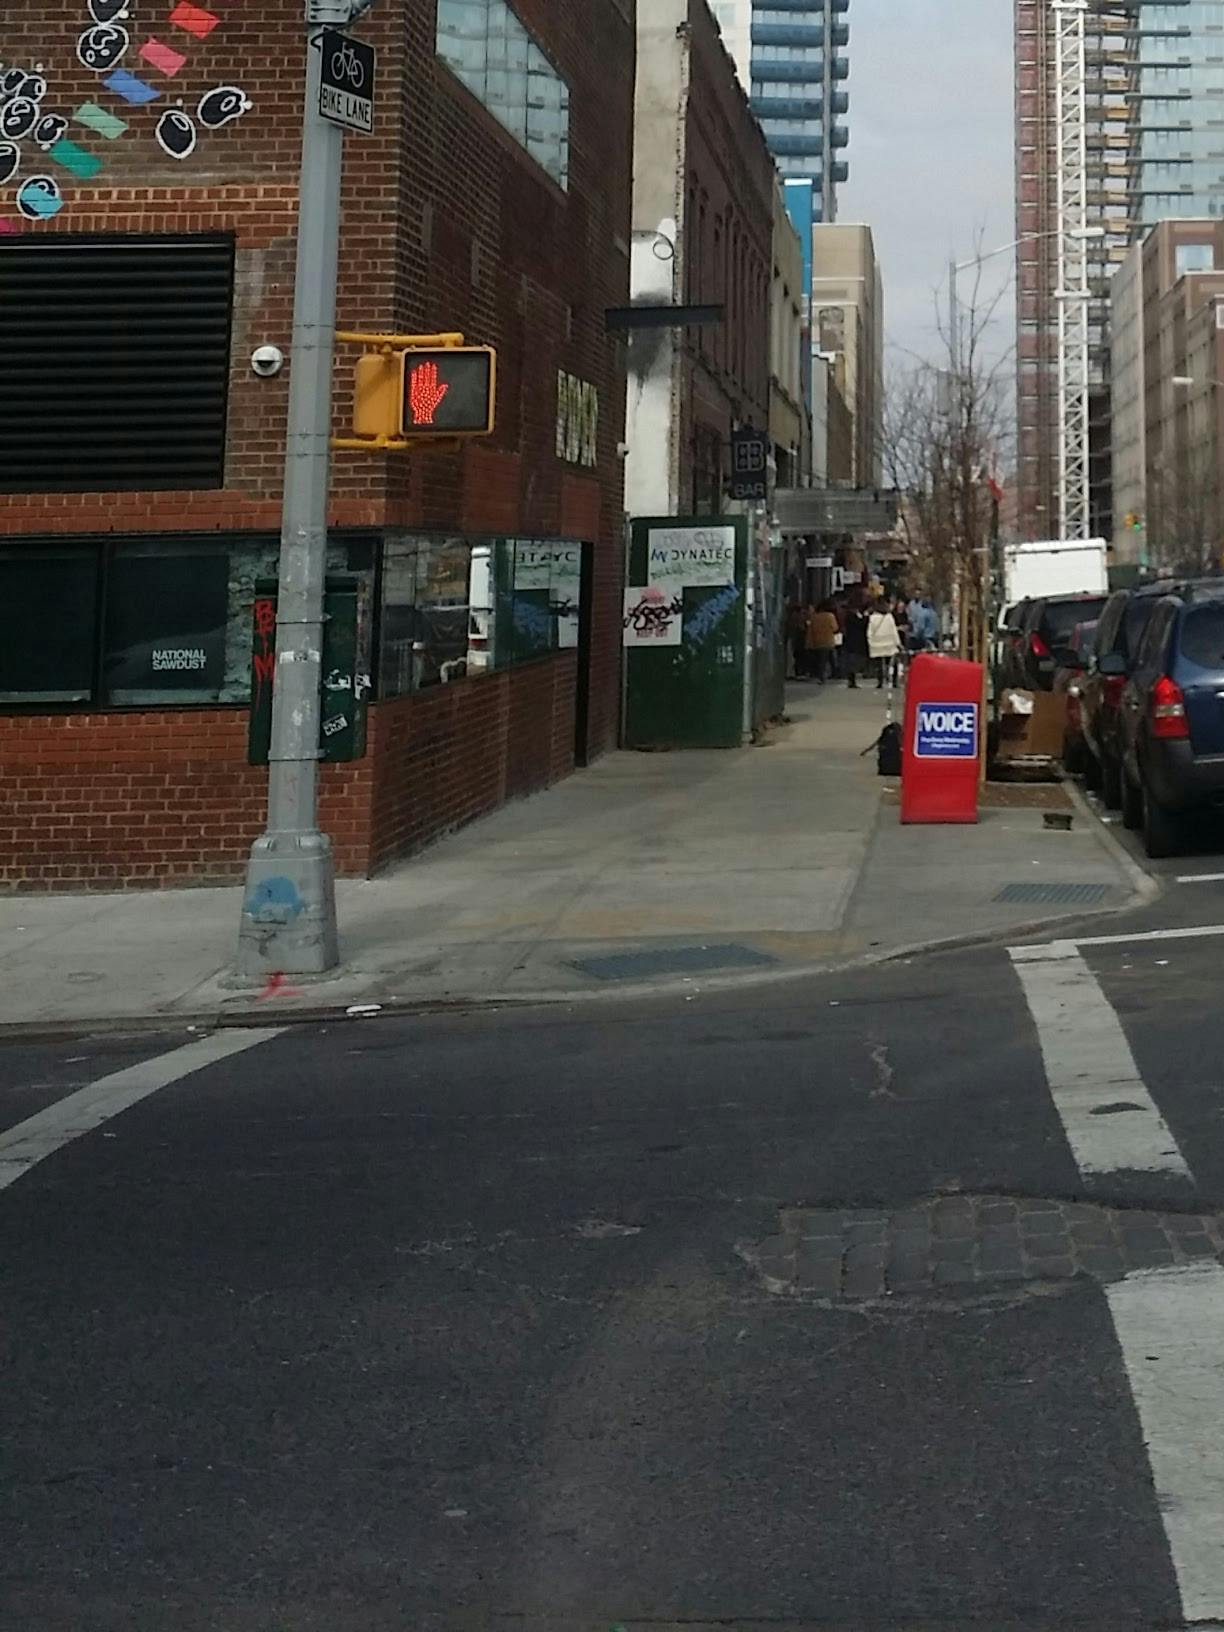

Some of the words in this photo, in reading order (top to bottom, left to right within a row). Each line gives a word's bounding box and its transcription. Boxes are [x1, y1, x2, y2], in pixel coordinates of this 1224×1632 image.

[323, 88, 342, 113] BIKE
[347, 97, 370, 123] LANE
[152, 649, 206, 659] NATIONAL
[153, 659, 206, 669] SAWDUST
[921, 712, 974, 732] VOICE
